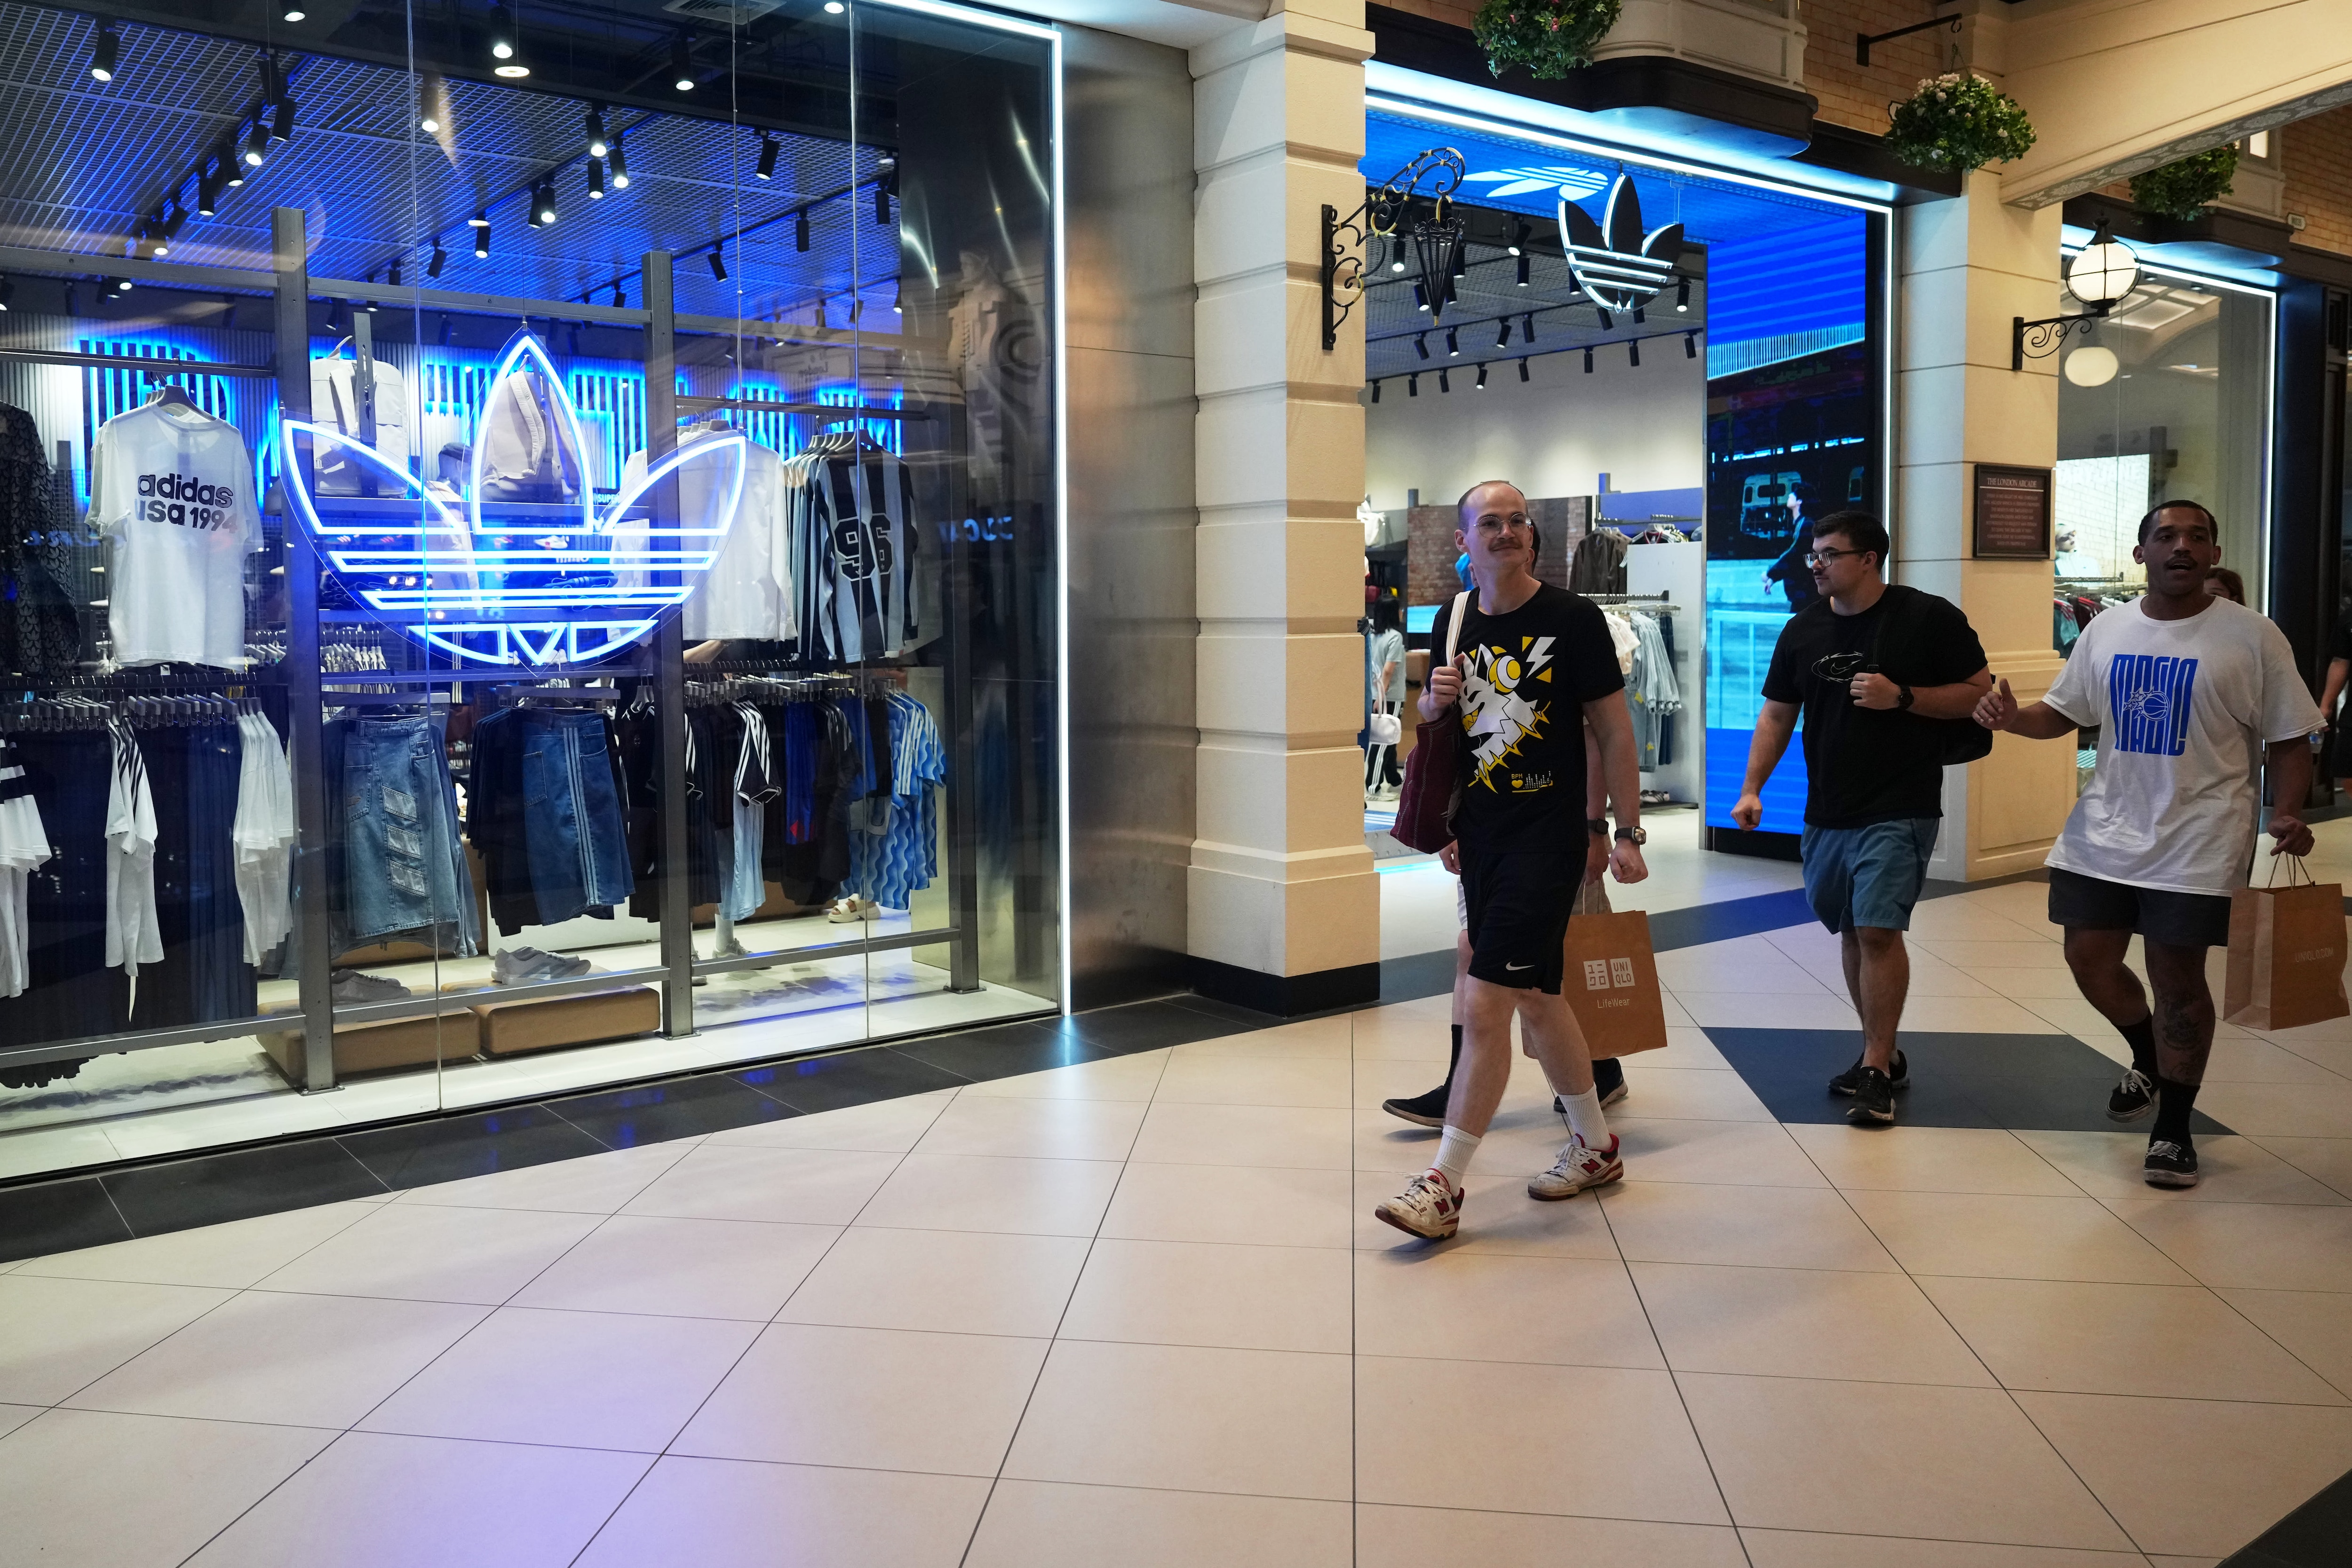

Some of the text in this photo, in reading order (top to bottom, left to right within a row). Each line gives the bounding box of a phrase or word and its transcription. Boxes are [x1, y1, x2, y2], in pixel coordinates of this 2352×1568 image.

[138, 473, 233, 508] adidas
[135, 499, 238, 533] usa 1994
[834, 513, 894, 581] 96
[2110, 654, 2199, 756] MAGIC
[1613, 961, 1628, 972] UNI
[1616, 973, 1631, 984] QLO
[1597, 998, 1630, 1009] LifeWear
